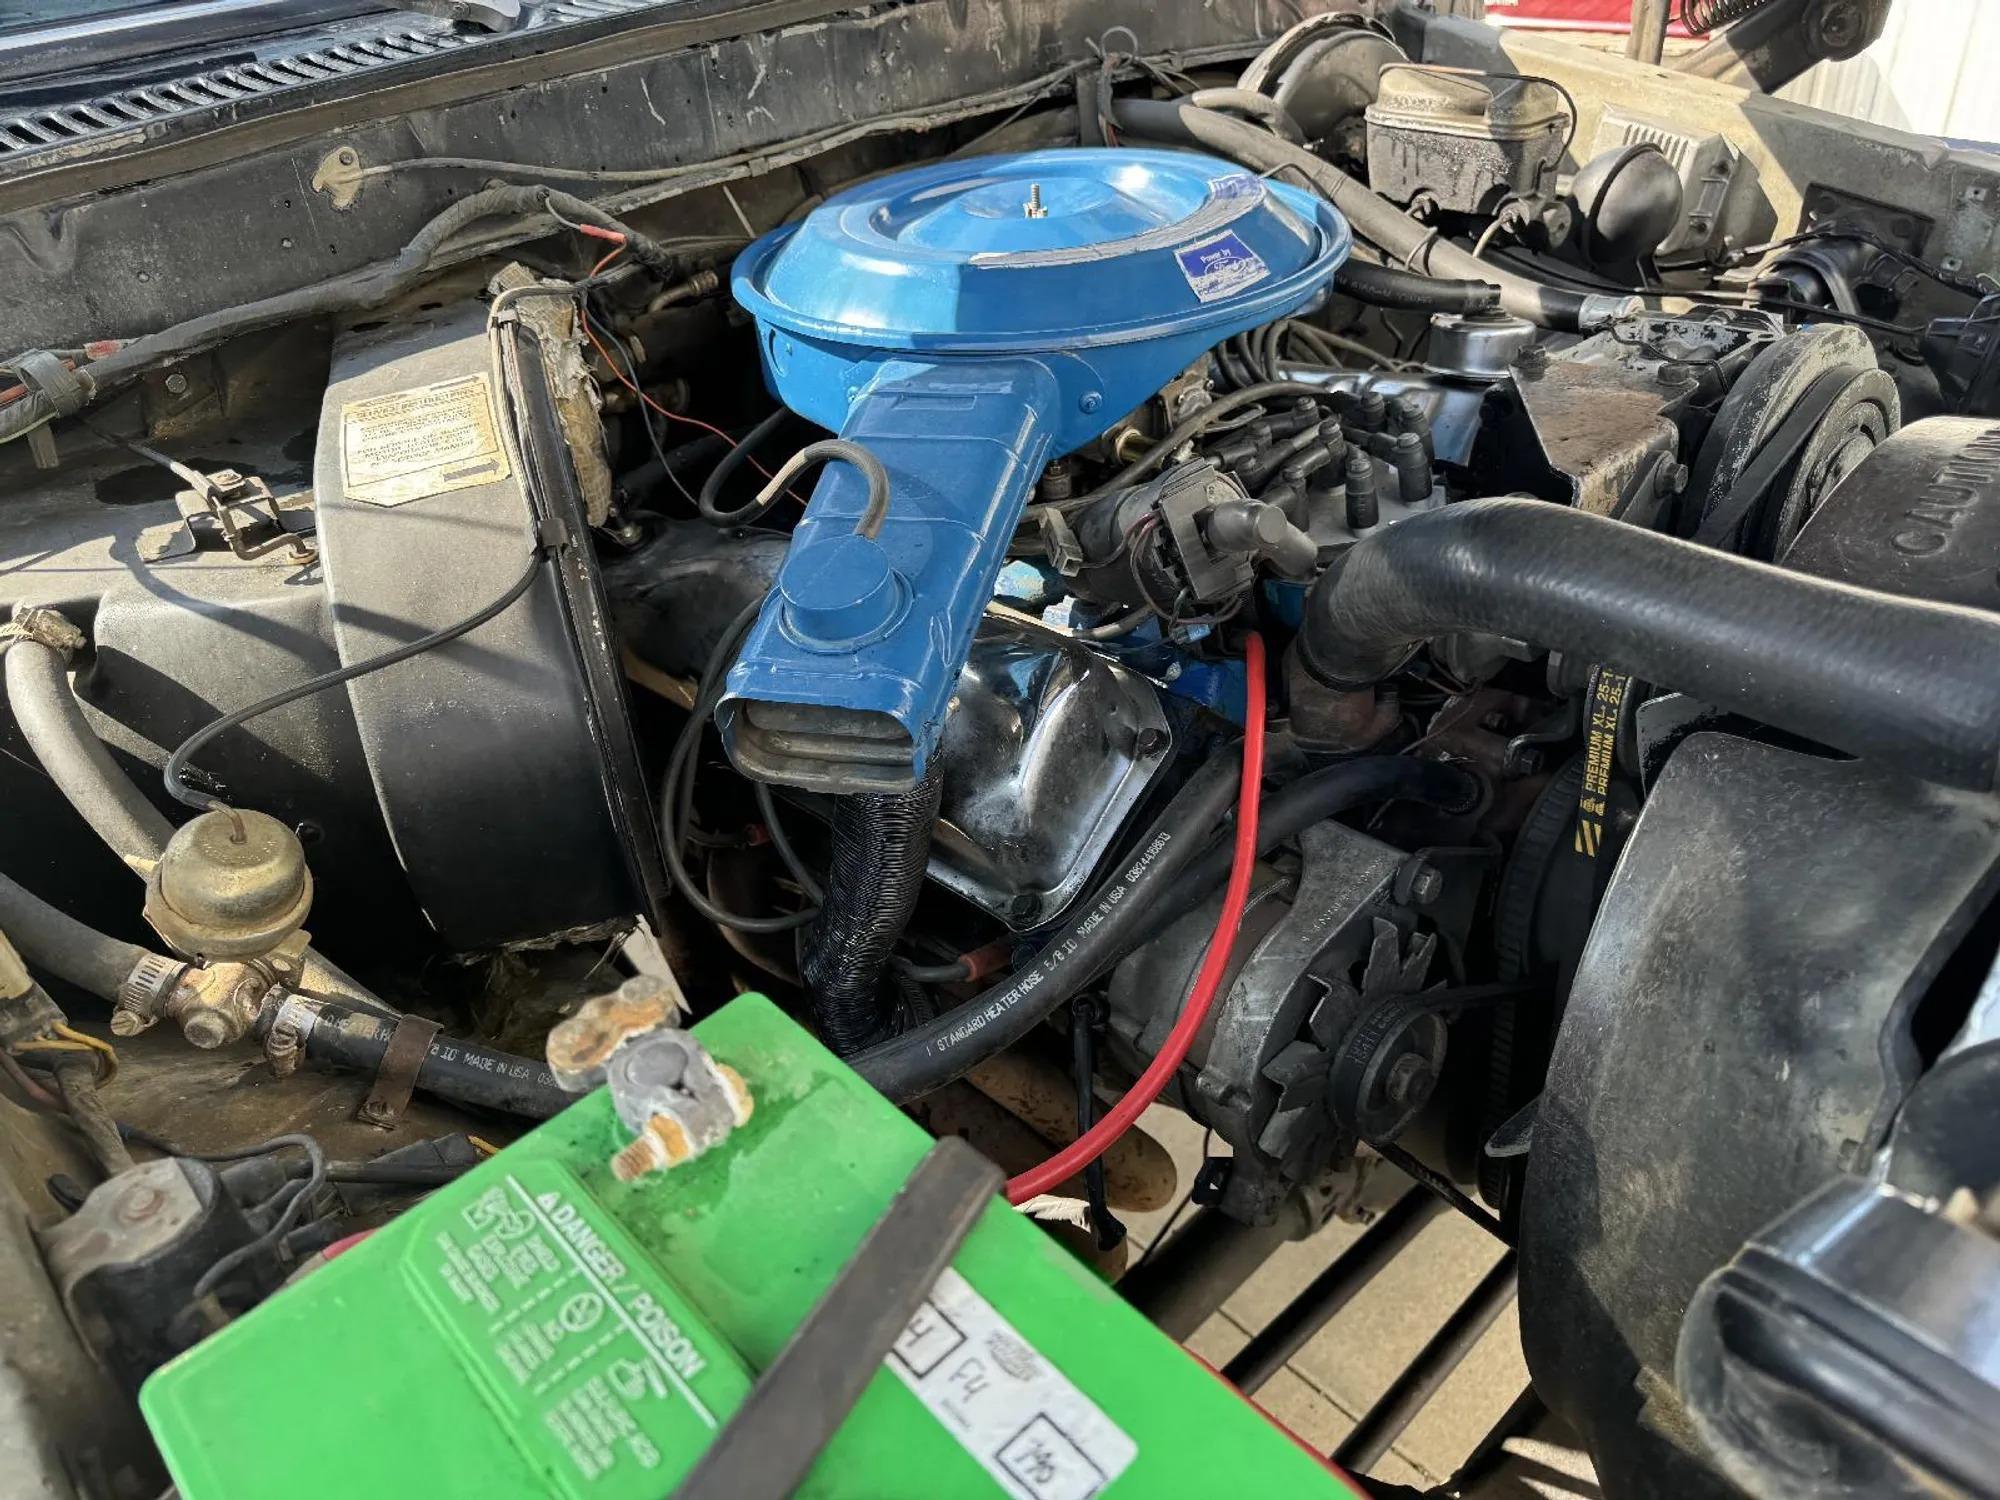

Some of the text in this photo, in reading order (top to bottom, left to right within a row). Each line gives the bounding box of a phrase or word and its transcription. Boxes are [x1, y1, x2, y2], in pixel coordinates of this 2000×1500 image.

[1585, 730, 1603, 792] PREMIUM
[1597, 668, 1614, 701] 25-1
[1597, 732, 1616, 796] PREMIUM
[936, 1014, 985, 1052] STANDARD
[984, 988, 1021, 1024] HEATER
[1018, 969, 1044, 996] HOSE
[1043, 949, 1065, 971] 5/8
[1076, 911, 1104, 938] MADE
[1098, 897, 1113, 918] IN
[1107, 884, 1127, 911] USA
[463, 1052, 496, 1072] MADE
[496, 1062, 509, 1076] IN
[508, 1064, 530, 1079] USA
[551, 1203, 627, 1284] DANGER
[628, 1292, 706, 1380] POISON
